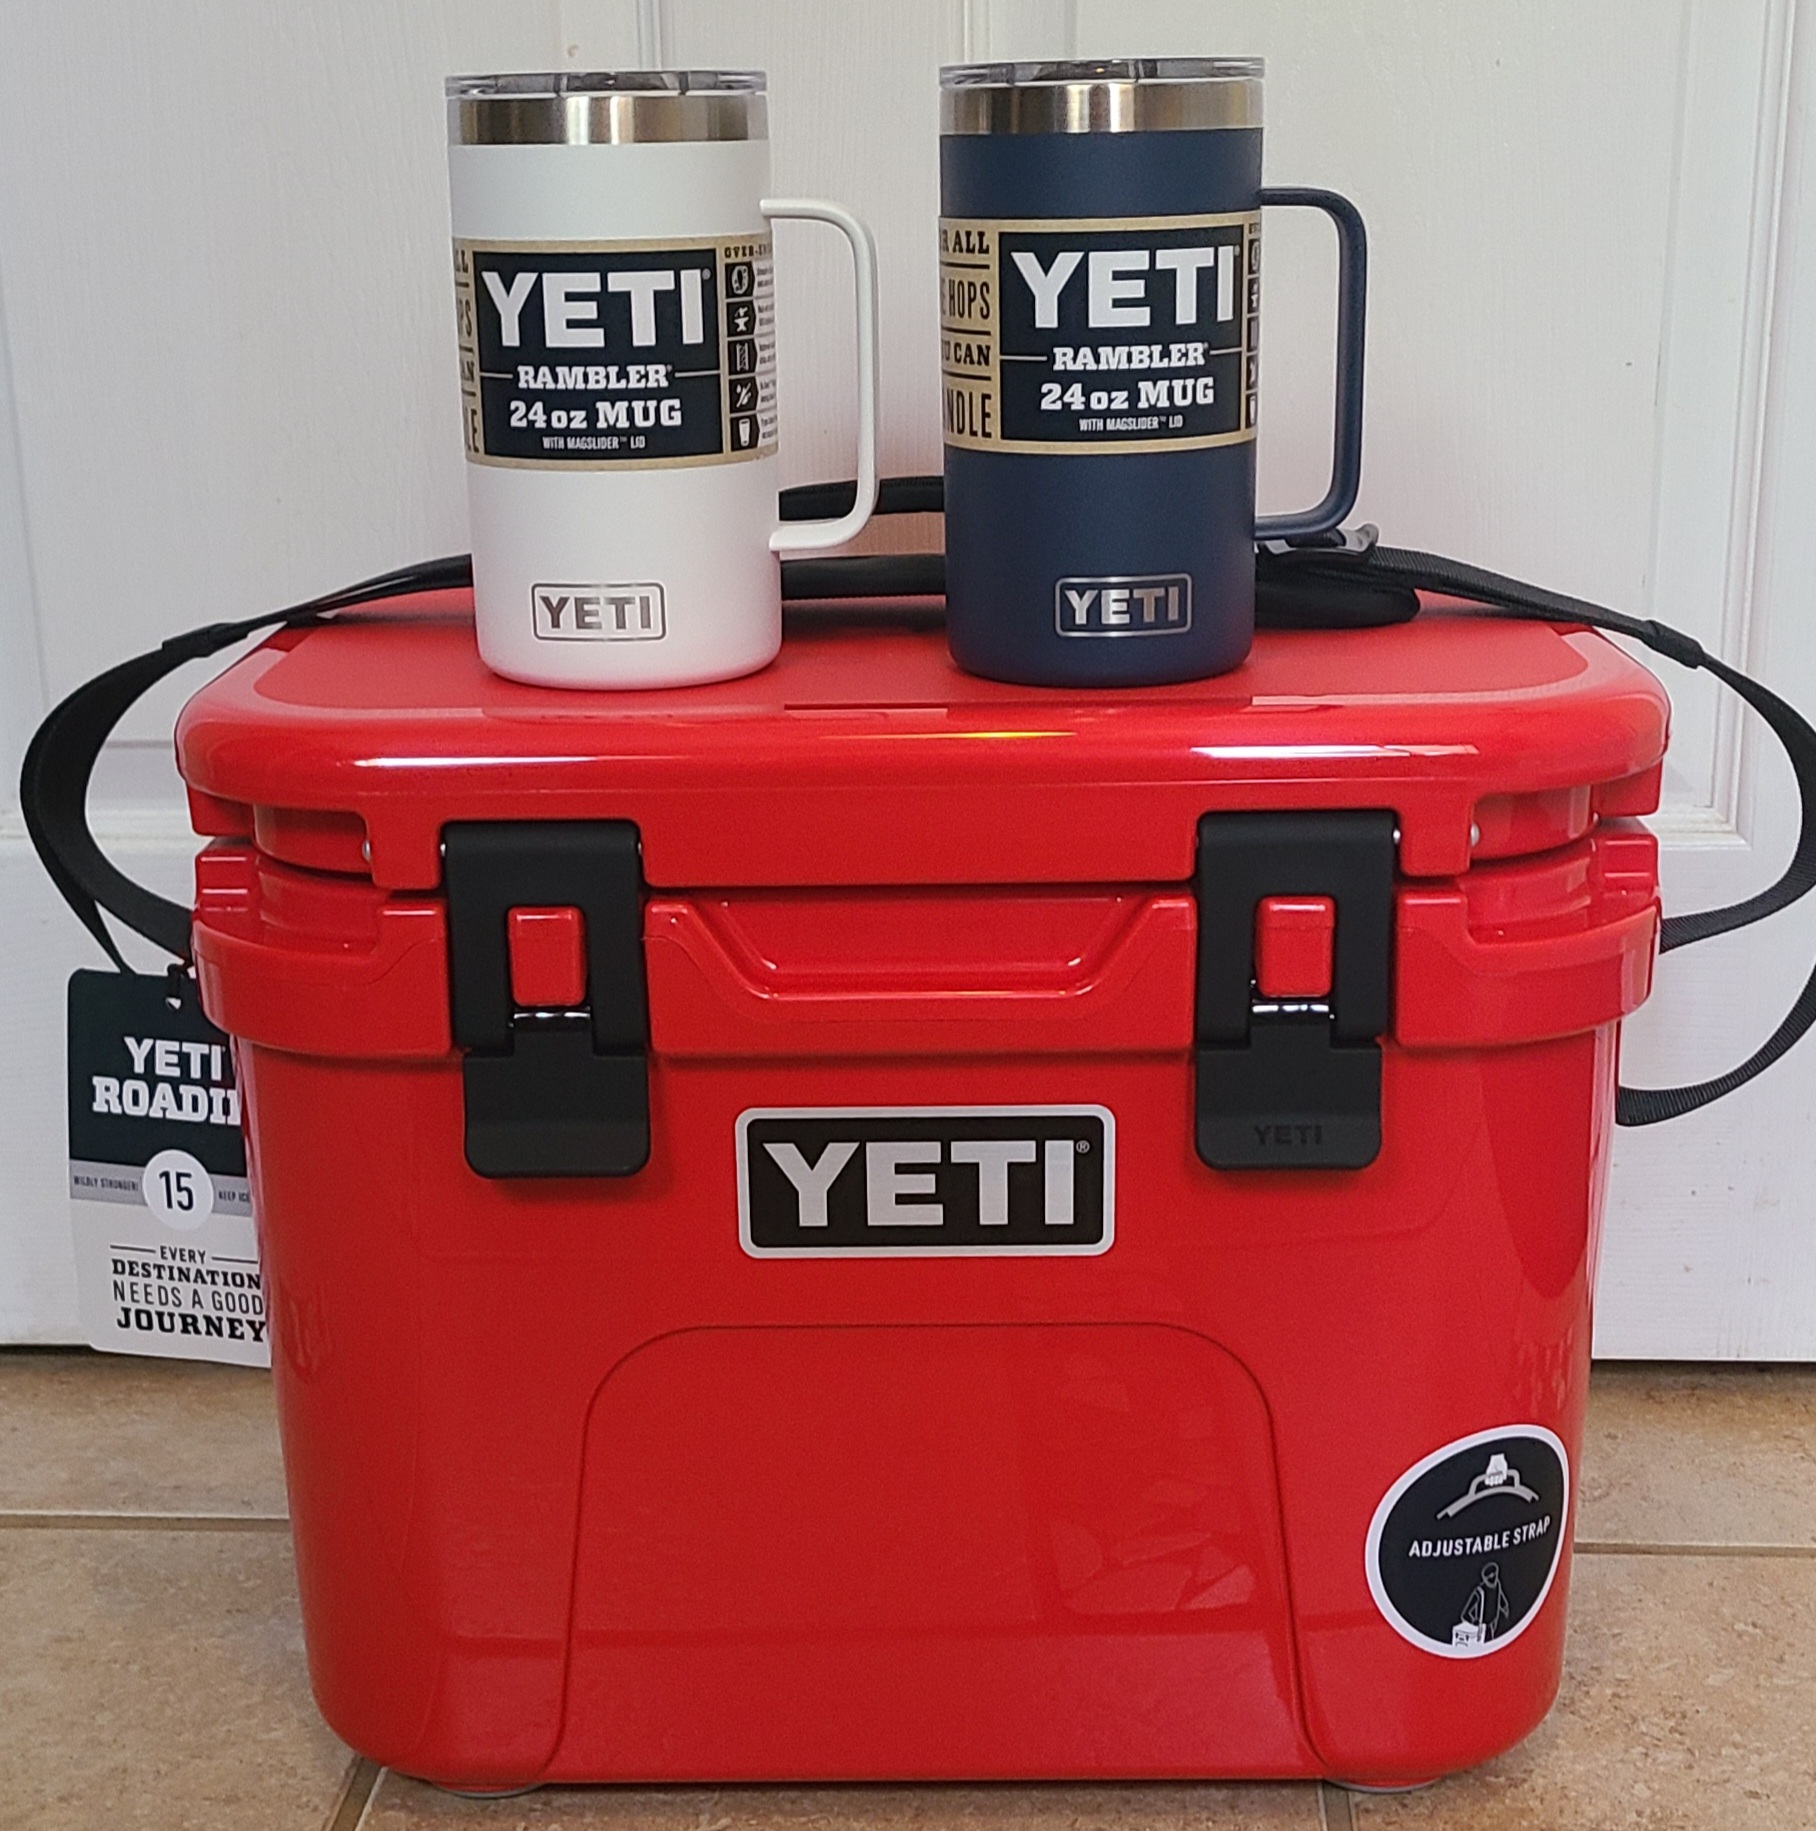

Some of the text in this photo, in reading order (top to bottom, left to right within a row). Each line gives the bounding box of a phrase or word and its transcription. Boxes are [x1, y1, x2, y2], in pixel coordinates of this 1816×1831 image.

[952, 230, 990, 255] ALL
[949, 281, 990, 320] HOPS
[953, 342, 991, 367] CAN
[1053, 343, 1205, 371] RAMBLER
[517, 364, 668, 390] RAMBLER
[1137, 377, 1214, 408] MUG
[596, 399, 682, 428] MUG
[1079, 418, 1104, 431] WITH
[1168, 414, 1183, 428] LID
[542, 436, 565, 449] WITH
[630, 435, 646, 449] LID
[539, 594, 653, 630] YETI
[1065, 586, 1180, 625] YETI
[124, 1036, 222, 1081] YETI
[1253, 1125, 1322, 1145] YETI
[73, 1175, 99, 1188] WILDLY
[158, 1170, 194, 1211] 15
[218, 1191, 236, 1201] KEEP
[159, 1245, 206, 1264] EVERY
[111, 1258, 261, 1290] DESTINATION
[113, 1279, 264, 1316] NEEDS A GOOD
[116, 1306, 267, 1343] JOURNEY
[1408, 1516, 1550, 1557] ADJUSTABLE STRAP
